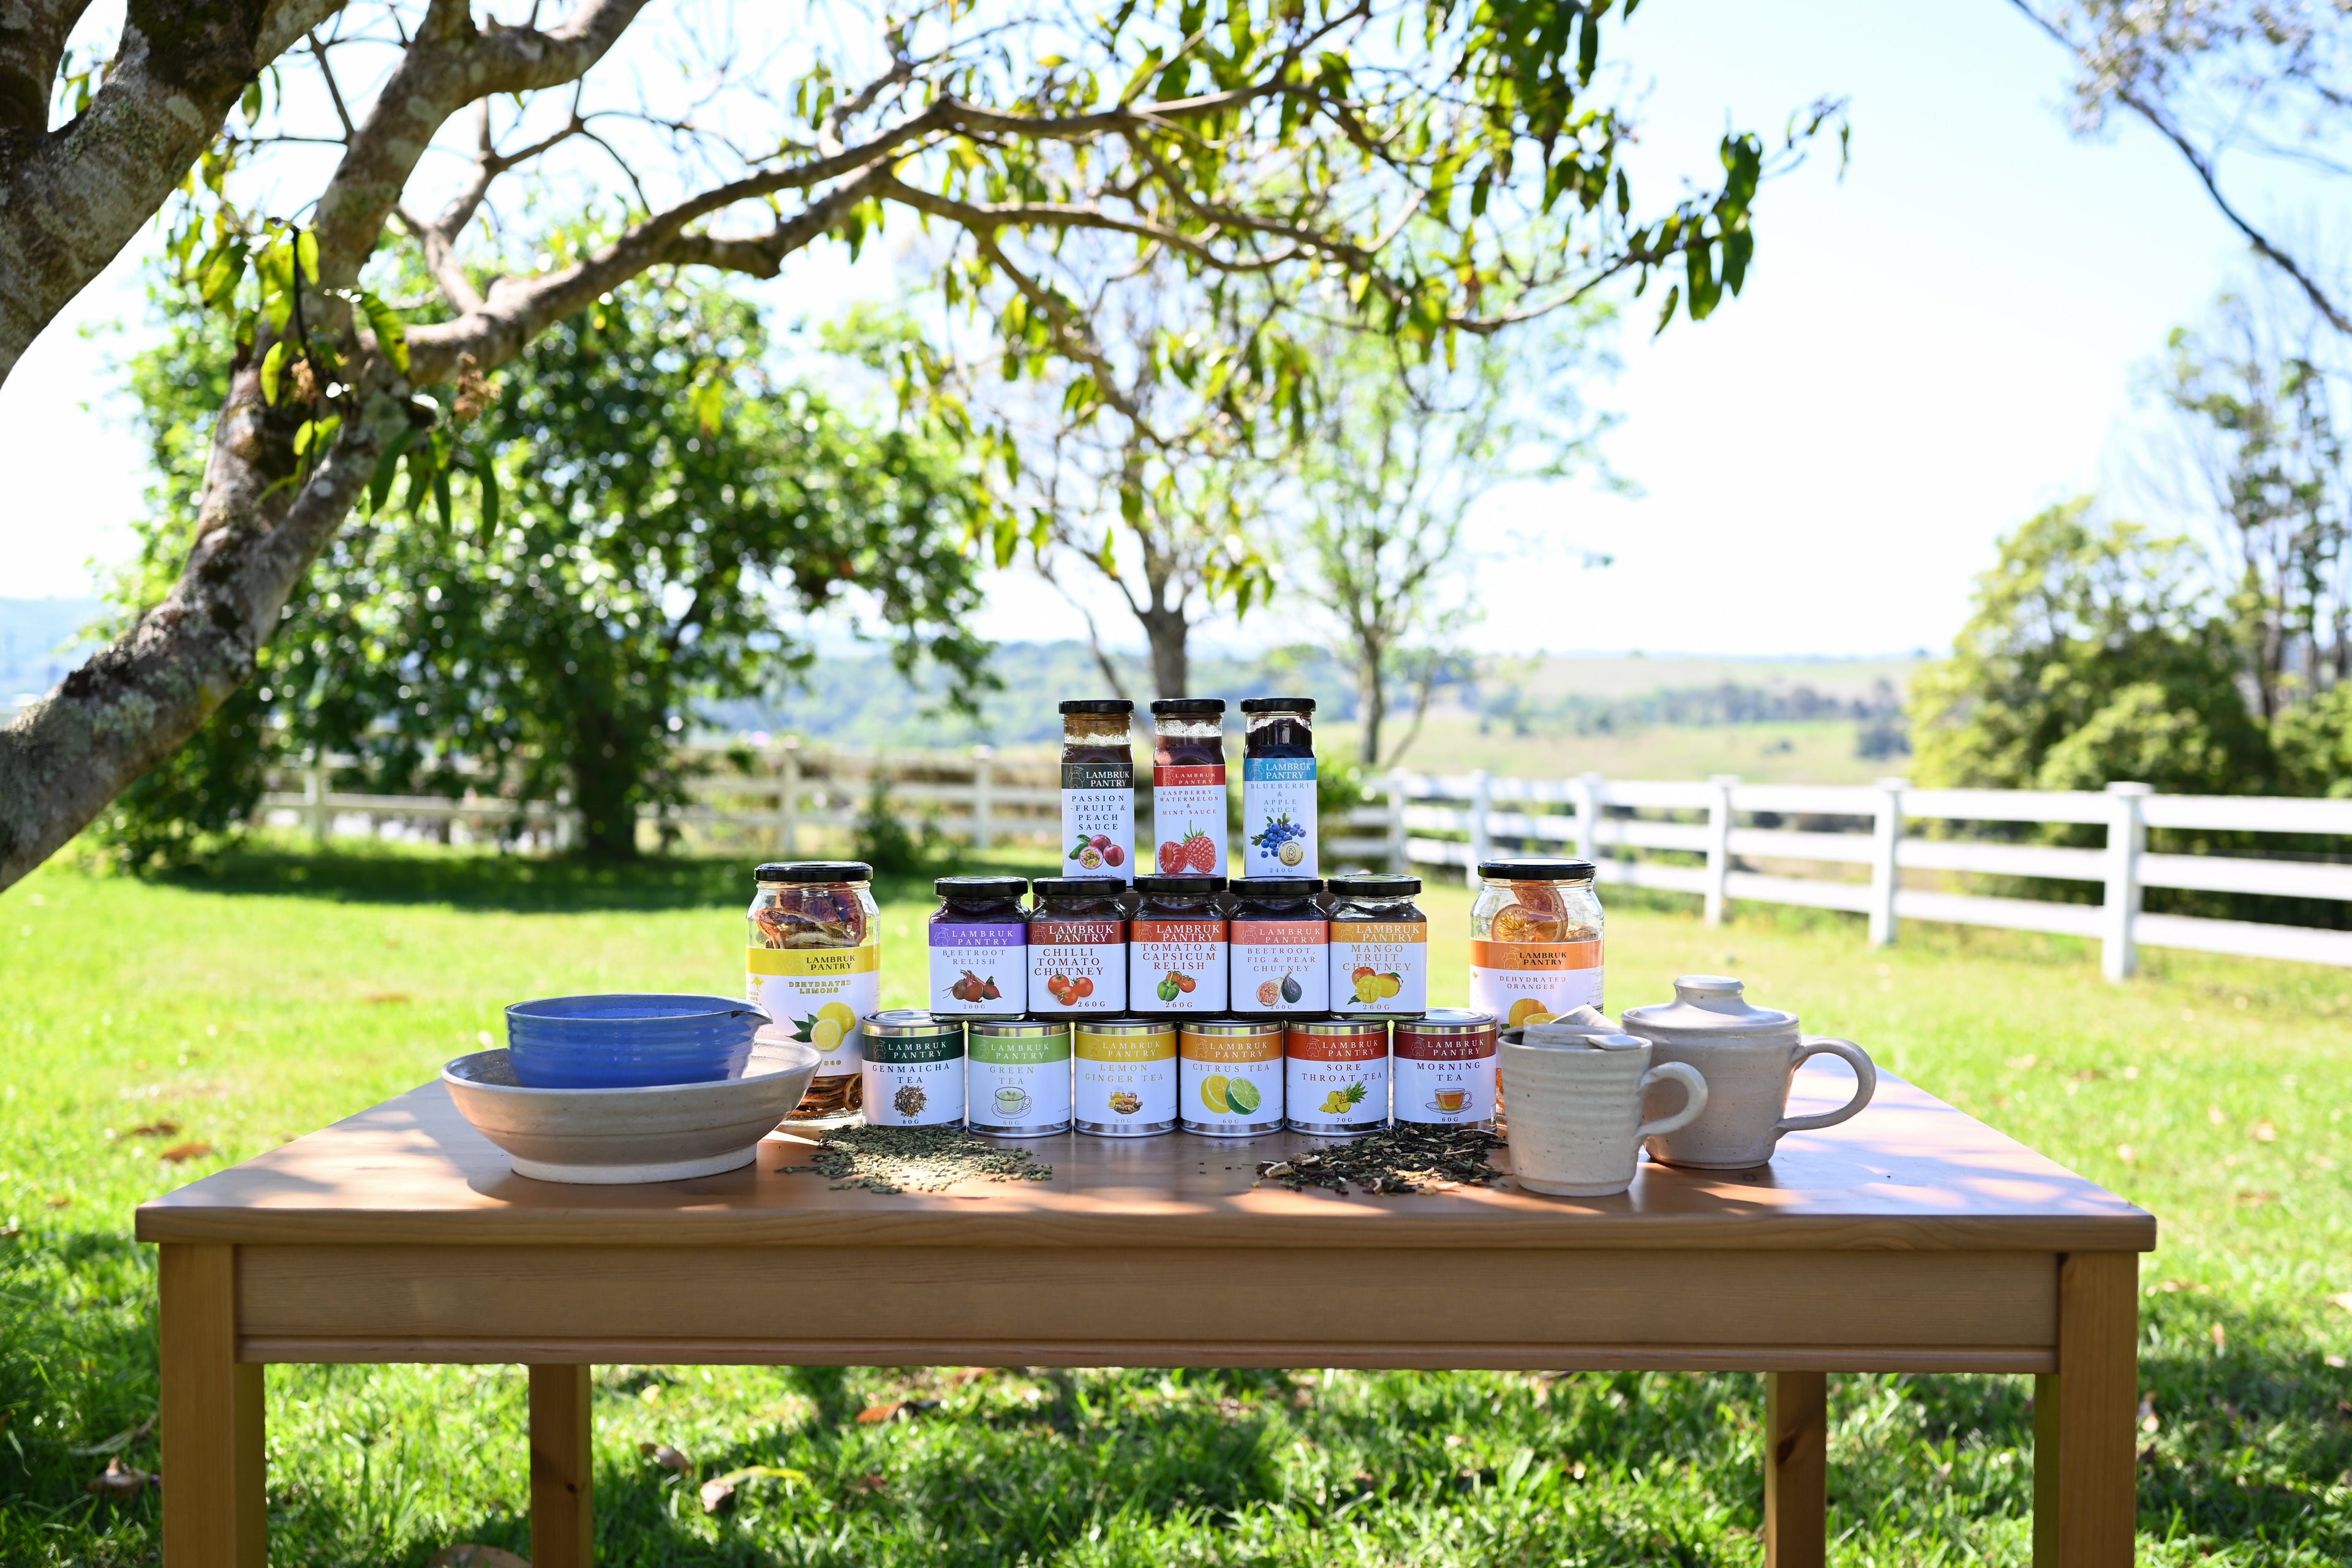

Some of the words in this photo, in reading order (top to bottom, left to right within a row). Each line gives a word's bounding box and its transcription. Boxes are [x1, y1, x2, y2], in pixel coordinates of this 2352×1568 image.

[1049, 925, 1114, 934] LAMBRUK
[1156, 925, 1220, 933] LAMBRUK
[1357, 925, 1420, 933] LAMBRUK
[1055, 934, 1108, 943] PANTRY
[1163, 933, 1215, 942] PANTRY
[1363, 933, 1414, 942] PANTRY
[807, 955, 856, 963] LAMBRUK
[889, 1041, 946, 1050] LAMBRUK
[1210, 1042, 1267, 1050] LAMBRUK
[1323, 1040, 1378, 1049] LAMBRUK
[1428, 1039, 1484, 1048] LAMBRUK
[1433, 1047, 1480, 1056] PANTRY
[872, 1063, 950, 1073] GENMAICHA
[1193, 1063, 1240, 1072] CITRUS
[1417, 1062, 1480, 1071] MORNING
[1085, 1073, 1133, 1082] GINGER
[1302, 1073, 1355, 1082] THROAT
[1363, 1072, 1382, 1080] TEA
